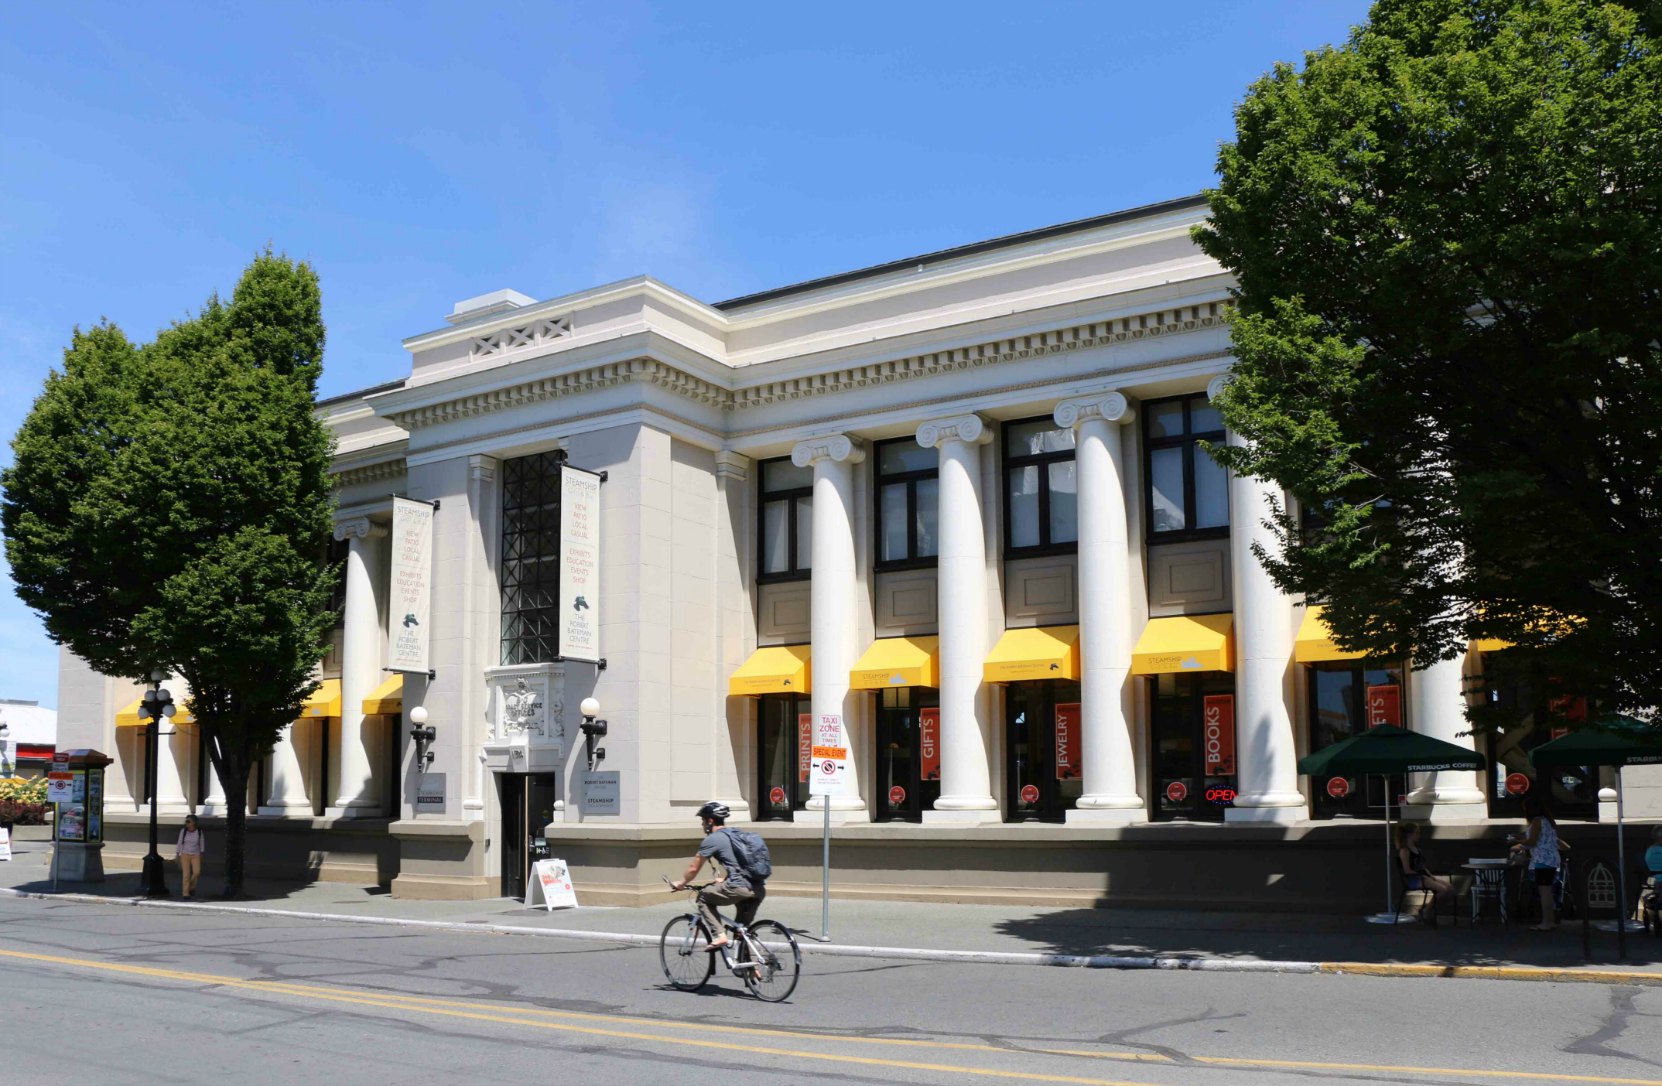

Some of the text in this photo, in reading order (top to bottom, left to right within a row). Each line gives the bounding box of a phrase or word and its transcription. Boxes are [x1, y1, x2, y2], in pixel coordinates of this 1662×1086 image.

[566, 476, 597, 490] STEAMSHIP
[397, 506, 430, 518] STEAMSHIP
[572, 521, 588, 530] LOCAL
[571, 529, 588, 539] CASUAL
[404, 546, 420, 554] LOCAL
[570, 548, 591, 558] EXHIBITS
[401, 554, 420, 562] CASUAL
[567, 557, 594, 568] EDUCATION
[400, 570, 422, 579] EXHIBITS
[570, 566, 589, 576] EVENTS
[396, 578, 424, 588] EDUCATION
[401, 588, 420, 596] EVENTS
[570, 620, 588, 630] ROBERT
[568, 628, 592, 637] BATEMAN
[569, 636, 590, 644] CENTRE
[396, 643, 421, 651] BATEMAN
[1148, 656, 1182, 664] STEAMSHIP
[1372, 698, 1384, 724] FTS
[923, 718, 933, 758] GIFTS
[1207, 706, 1220, 762] BOOKS
[1058, 714, 1070, 768] JEWELRY
[802, 723, 810, 771] PRINTS
[814, 748, 846, 757] SPECIAL EVENT
